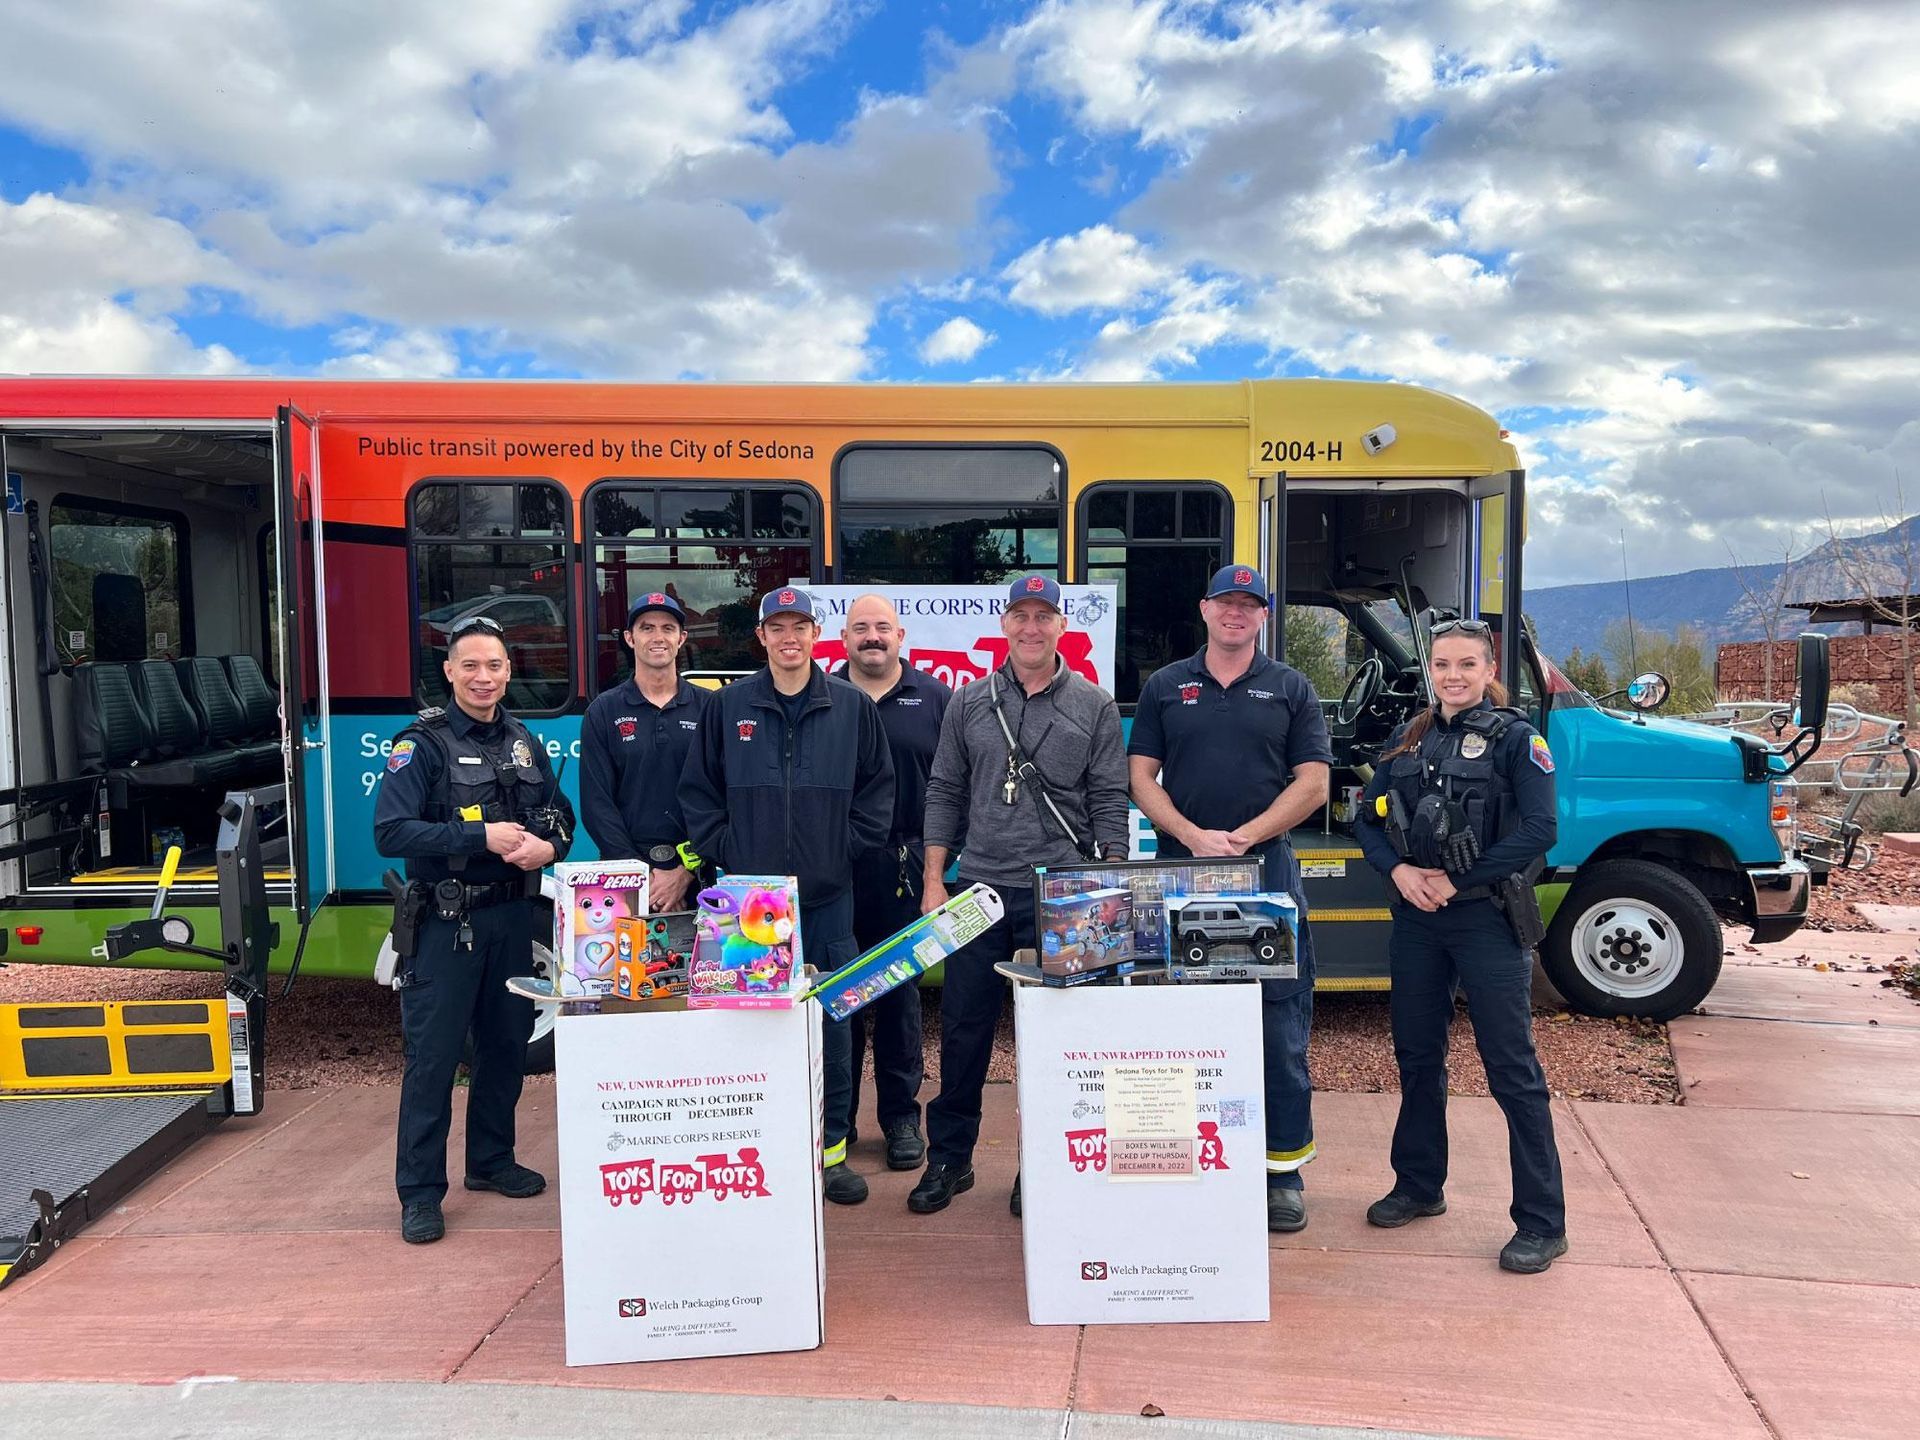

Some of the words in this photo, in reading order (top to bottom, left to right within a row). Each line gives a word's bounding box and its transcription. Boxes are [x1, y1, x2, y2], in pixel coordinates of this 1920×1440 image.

[358, 438, 423, 458] Public
[430, 438, 496, 457] transit
[504, 439, 594, 460] powered
[602, 440, 624, 462] by
[631, 440, 662, 459] the
[670, 440, 706, 462] City
[713, 440, 732, 460] of
[738, 440, 814, 460] Sedona
[1261, 441, 1342, 462] 2004-H
[916, 598, 983, 616] CORPS
[568, 872, 601, 886] CARE
[604, 875, 646, 890] BEARS
[1220, 968, 1248, 978] Jeep
[1064, 1052, 1092, 1061] NEW,
[1094, 1050, 1164, 1060] UNWRAPPED
[1166, 1050, 1194, 1060] TOYS
[1197, 1049, 1227, 1060] ONLY
[1142, 1068, 1156, 1076] Toys
[597, 1082, 626, 1092] NEW,
[629, 1077, 702, 1090] UNWRAPPED
[706, 1075, 735, 1086] TOYS
[738, 1072, 769, 1084] ONLY
[602, 1098, 664, 1110] CAMPAIGN
[667, 1096, 697, 1108] RUNS
[708, 1092, 764, 1105] OCTOBER
[612, 1112, 671, 1123] THROUGH
[688, 1107, 754, 1120] DECEMBER
[626, 1134, 671, 1146] MARINE
[673, 1132, 709, 1144] CORPS
[712, 1130, 762, 1142] RESERVE
[604, 1167, 650, 1191] TOYS
[661, 1169, 698, 1190] FOR
[709, 1166, 758, 1188] TOTS
[1110, 1264, 1138, 1274] Welch
[1141, 1264, 1187, 1277] Packaging
[1189, 1264, 1219, 1276] Group
[649, 1300, 679, 1312] Welch
[682, 1296, 731, 1311] Packaging
[732, 1295, 763, 1306] Group
